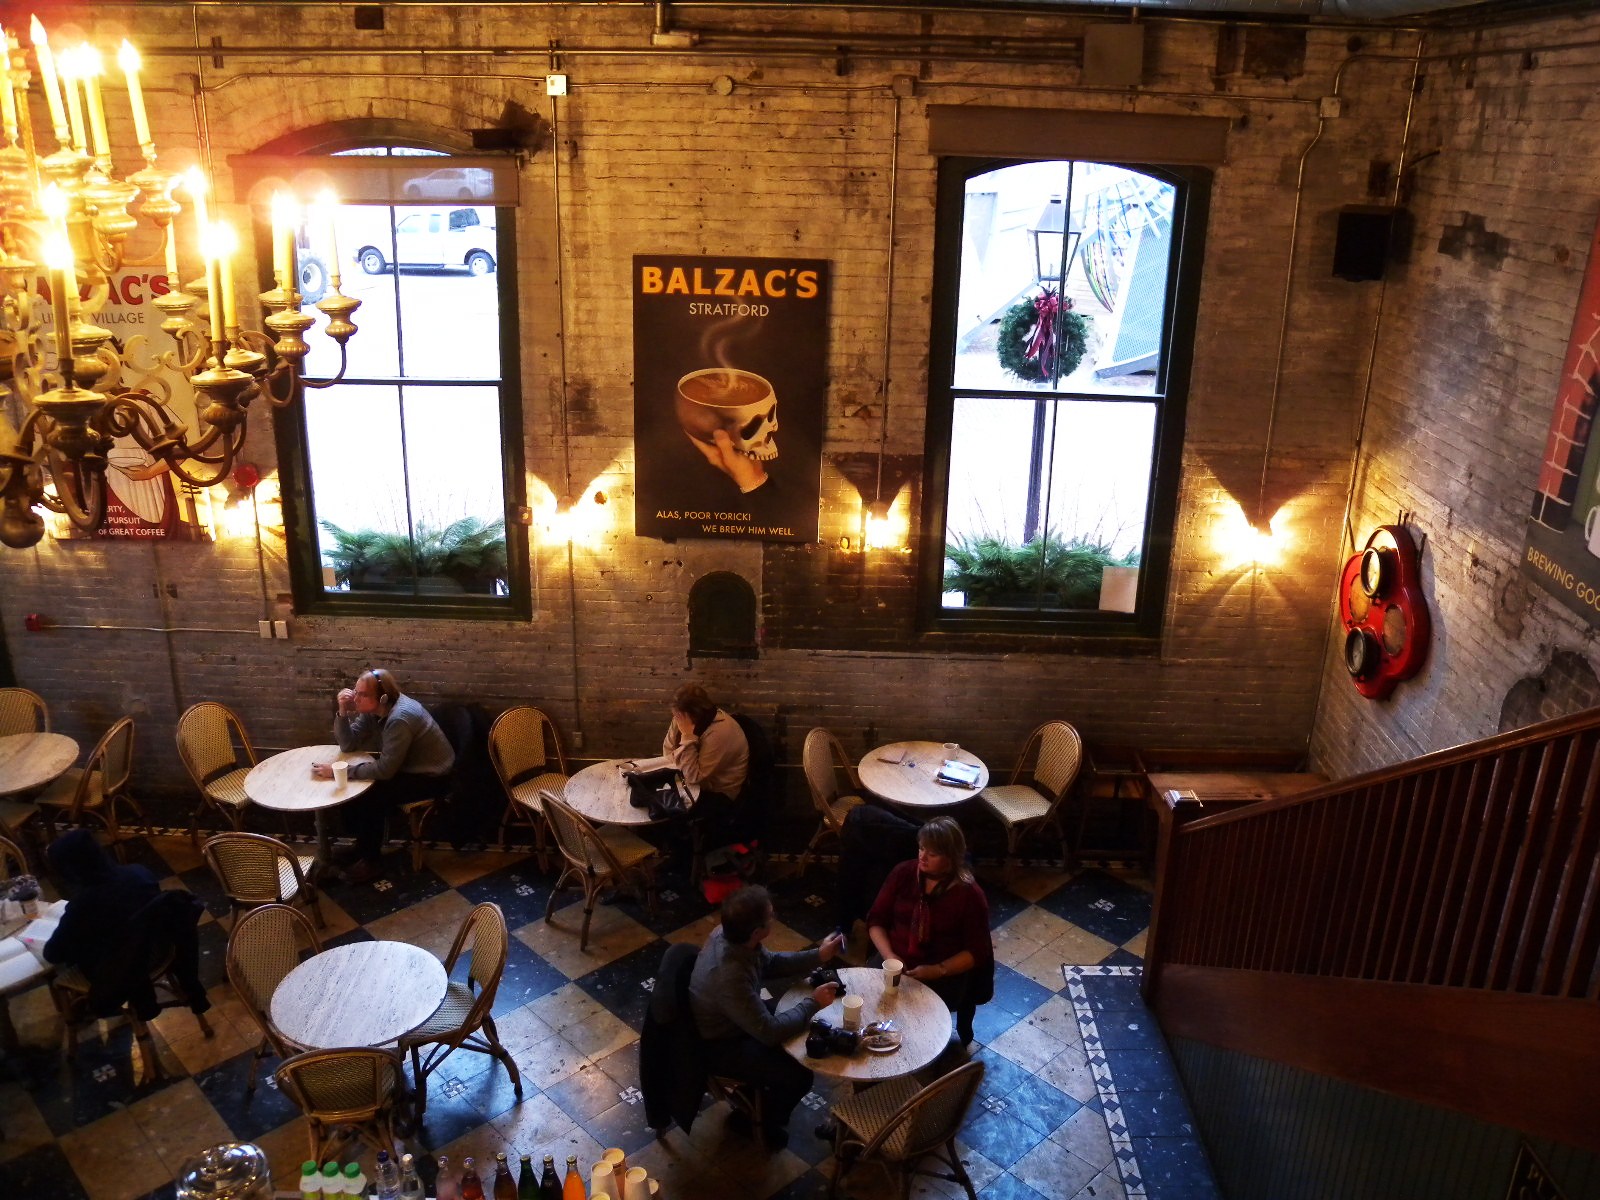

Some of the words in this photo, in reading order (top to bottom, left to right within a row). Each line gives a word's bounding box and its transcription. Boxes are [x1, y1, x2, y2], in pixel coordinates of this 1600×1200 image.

[641, 266, 819, 299] BALZAC'S
[688, 302, 770, 318] STRATFORD
[91, 312, 145, 325] VILLAGE
[108, 516, 141, 524] PURSUIT
[655, 510, 682, 521] ALAS,
[684, 511, 711, 521] POOR
[108, 528, 134, 536] GREAT
[136, 528, 165, 536] COFFEE
[702, 524, 717, 534] WE
[719, 525, 746, 535] BREW
[748, 526, 766, 536] HIM
[1527, 546, 1574, 590] BREWING
